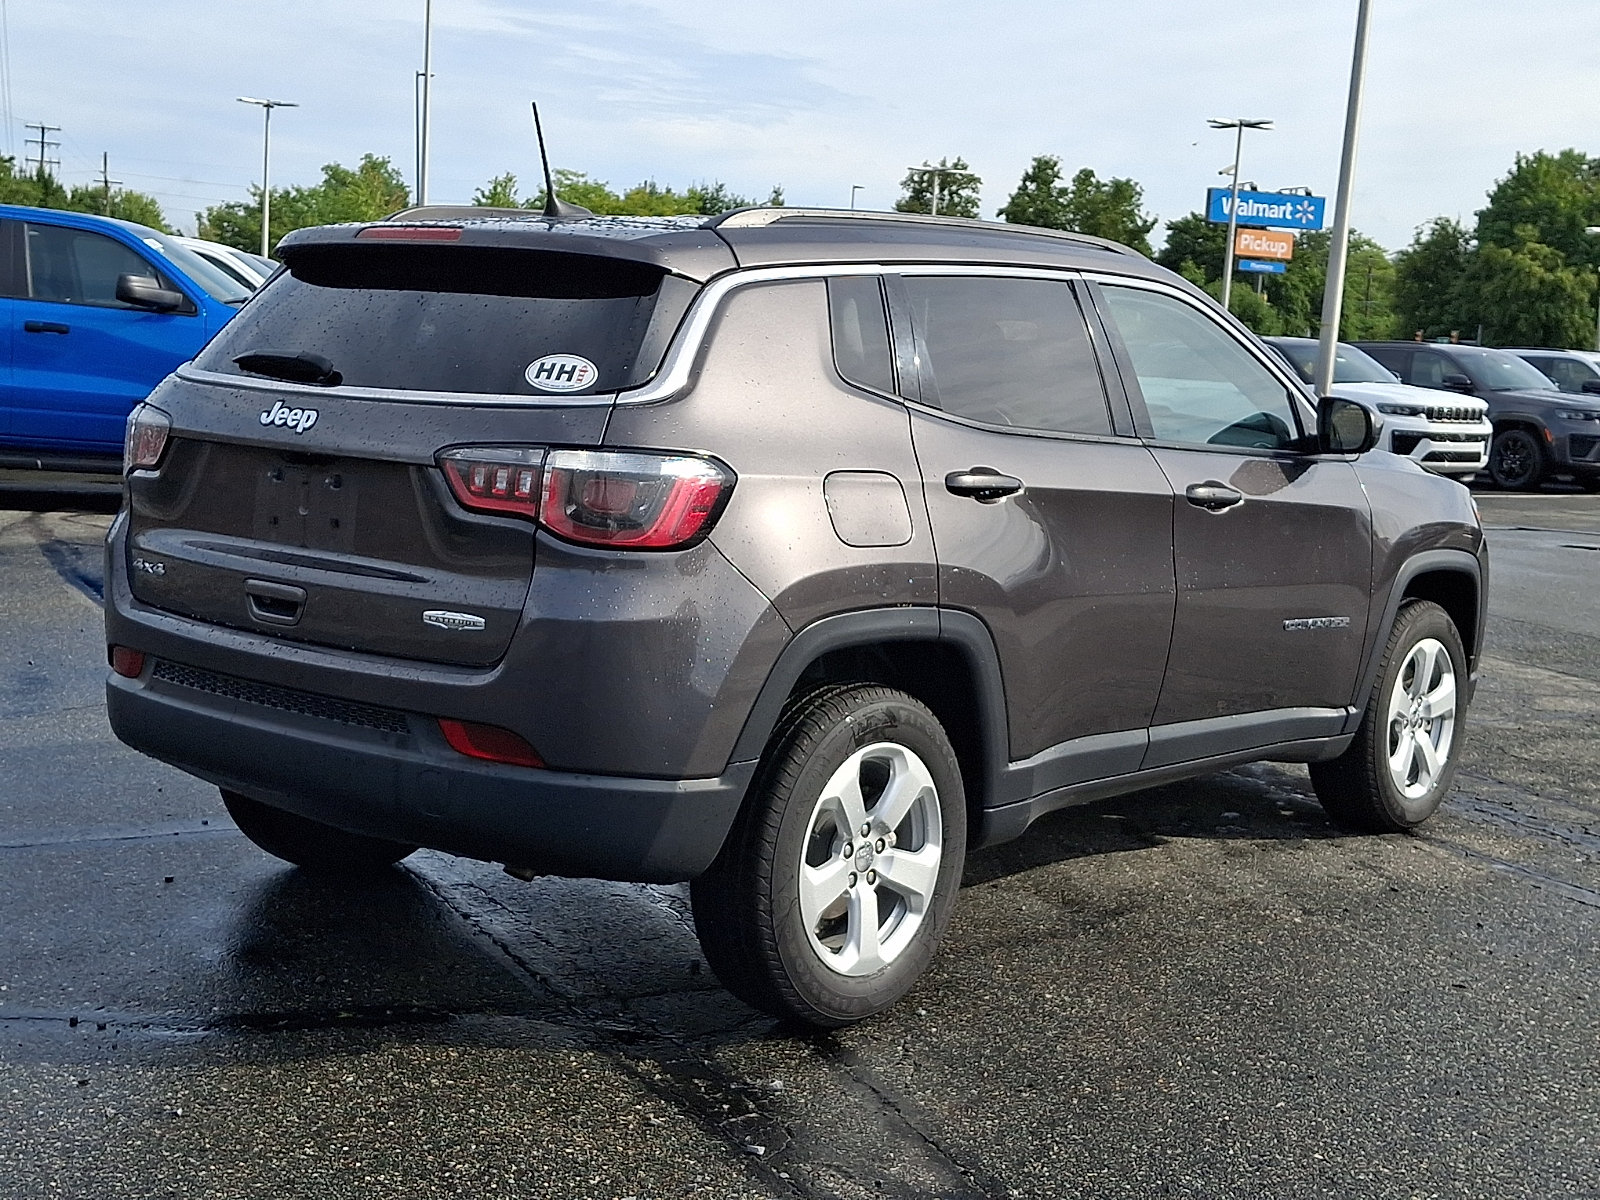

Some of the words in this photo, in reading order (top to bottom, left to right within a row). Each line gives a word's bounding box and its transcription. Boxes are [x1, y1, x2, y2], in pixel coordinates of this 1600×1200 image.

[1222, 197, 1293, 220] Walmart
[1240, 234, 1288, 258] Pickup
[260, 400, 318, 434] Jeep
